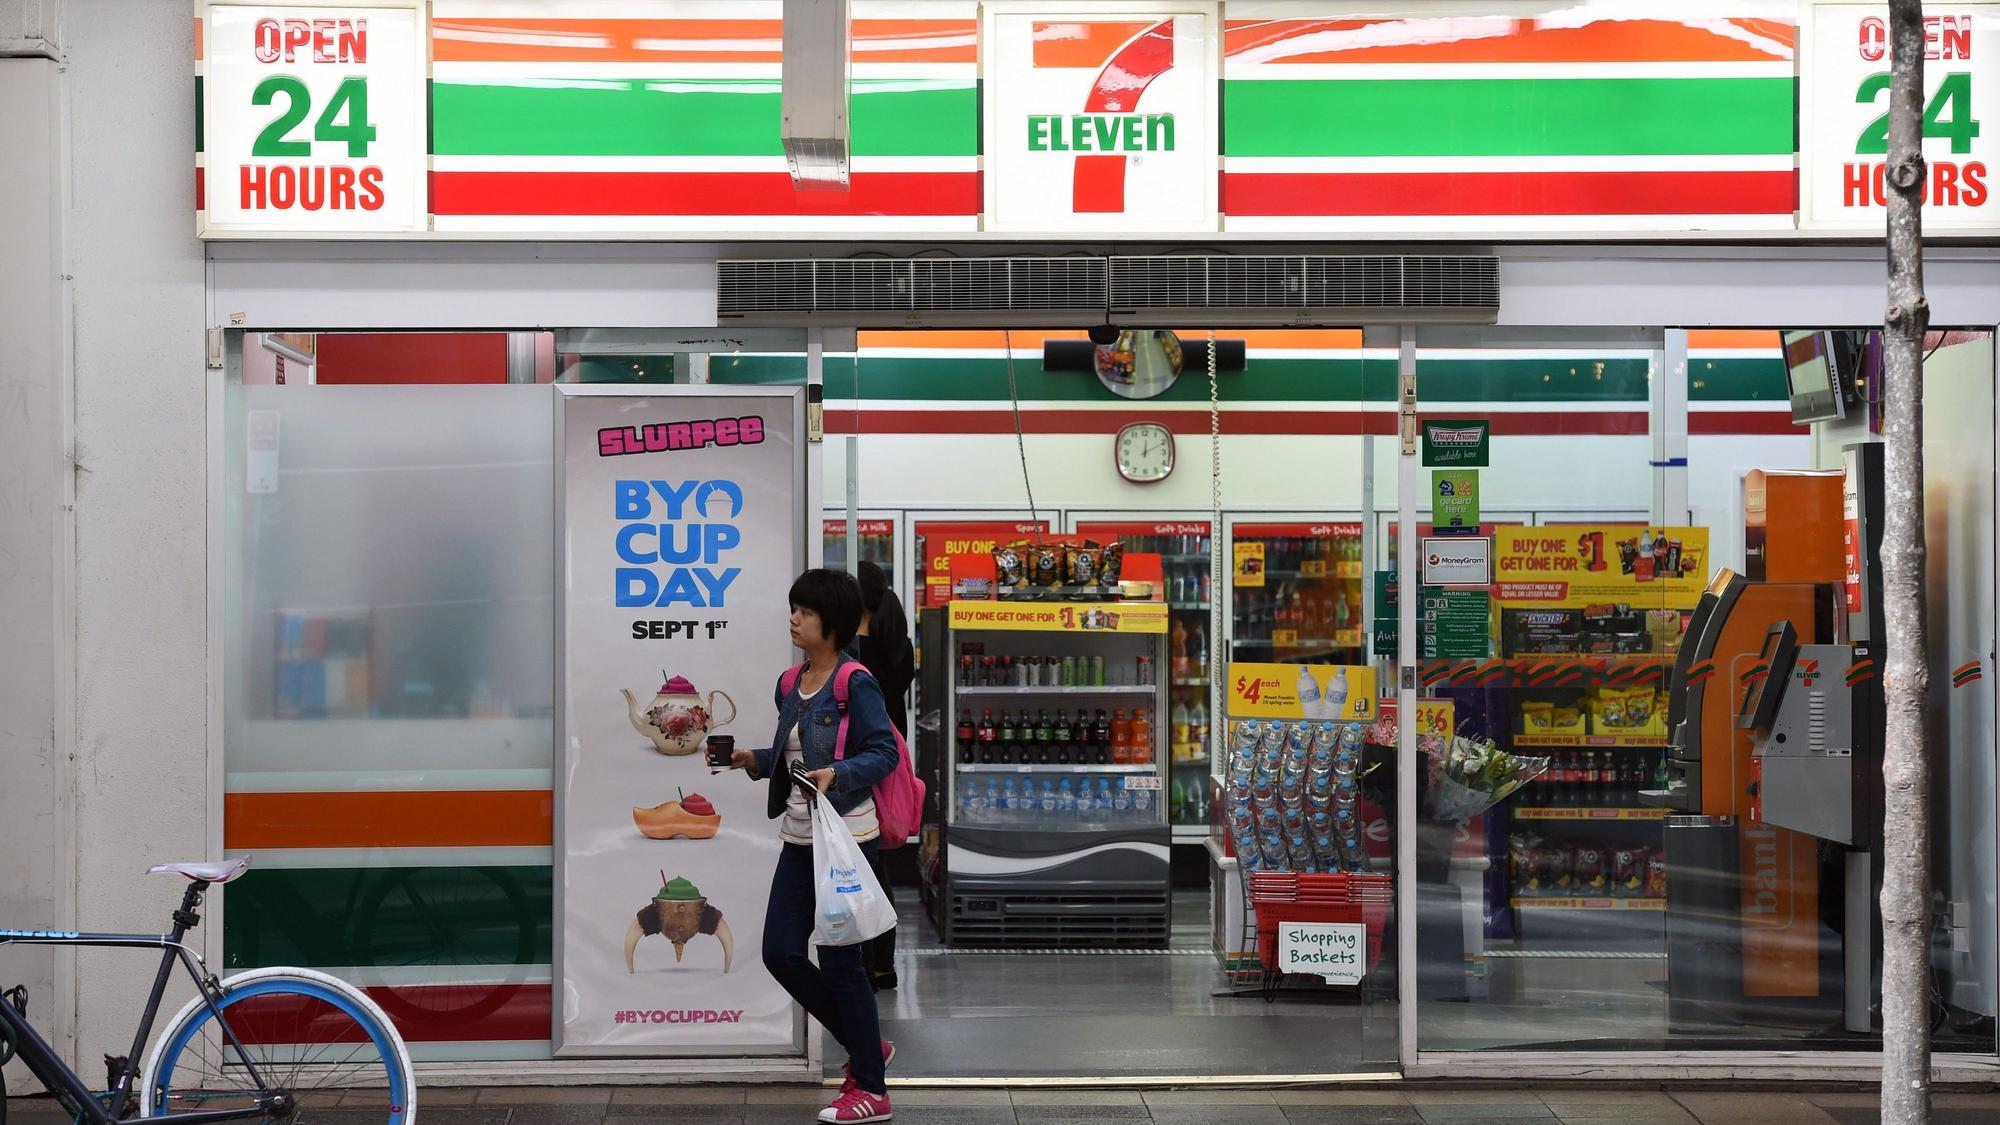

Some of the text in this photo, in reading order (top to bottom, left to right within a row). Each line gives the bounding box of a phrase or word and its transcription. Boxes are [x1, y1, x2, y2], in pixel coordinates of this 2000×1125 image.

[255, 18, 367, 64] OPEN
[1859, 16, 1972, 61] OEN
[251, 73, 376, 158] 24
[1032, 19, 1174, 213] 7
[239, 164, 385, 211] HOURS
[1843, 161, 1988, 207] HORS
[615, 480, 743, 519] BYO
[1445, 505, 1467, 513] here
[1310, 525, 1331, 535] Soft
[615, 523, 741, 565] CUP
[945, 540, 970, 554] BUY
[1512, 539, 1566, 555] BUY ONE
[934, 557, 950, 570] GE
[1441, 557, 1485, 565] MoneyGram
[1500, 557, 1578, 571] GET ONE FOR
[615, 568, 742, 608] DAY
[954, 607, 1075, 629] BUY ONE GET ONE FOR $1
[1529, 613, 1564, 624] SNICKERS
[632, 621, 699, 640] SEPT
[1236, 675, 1280, 704] $4 each
[1289, 929, 1356, 949] Shopping
[1290, 948, 1355, 964] Baskets
[614, 1010, 744, 1024] #BYOCUPDAY
